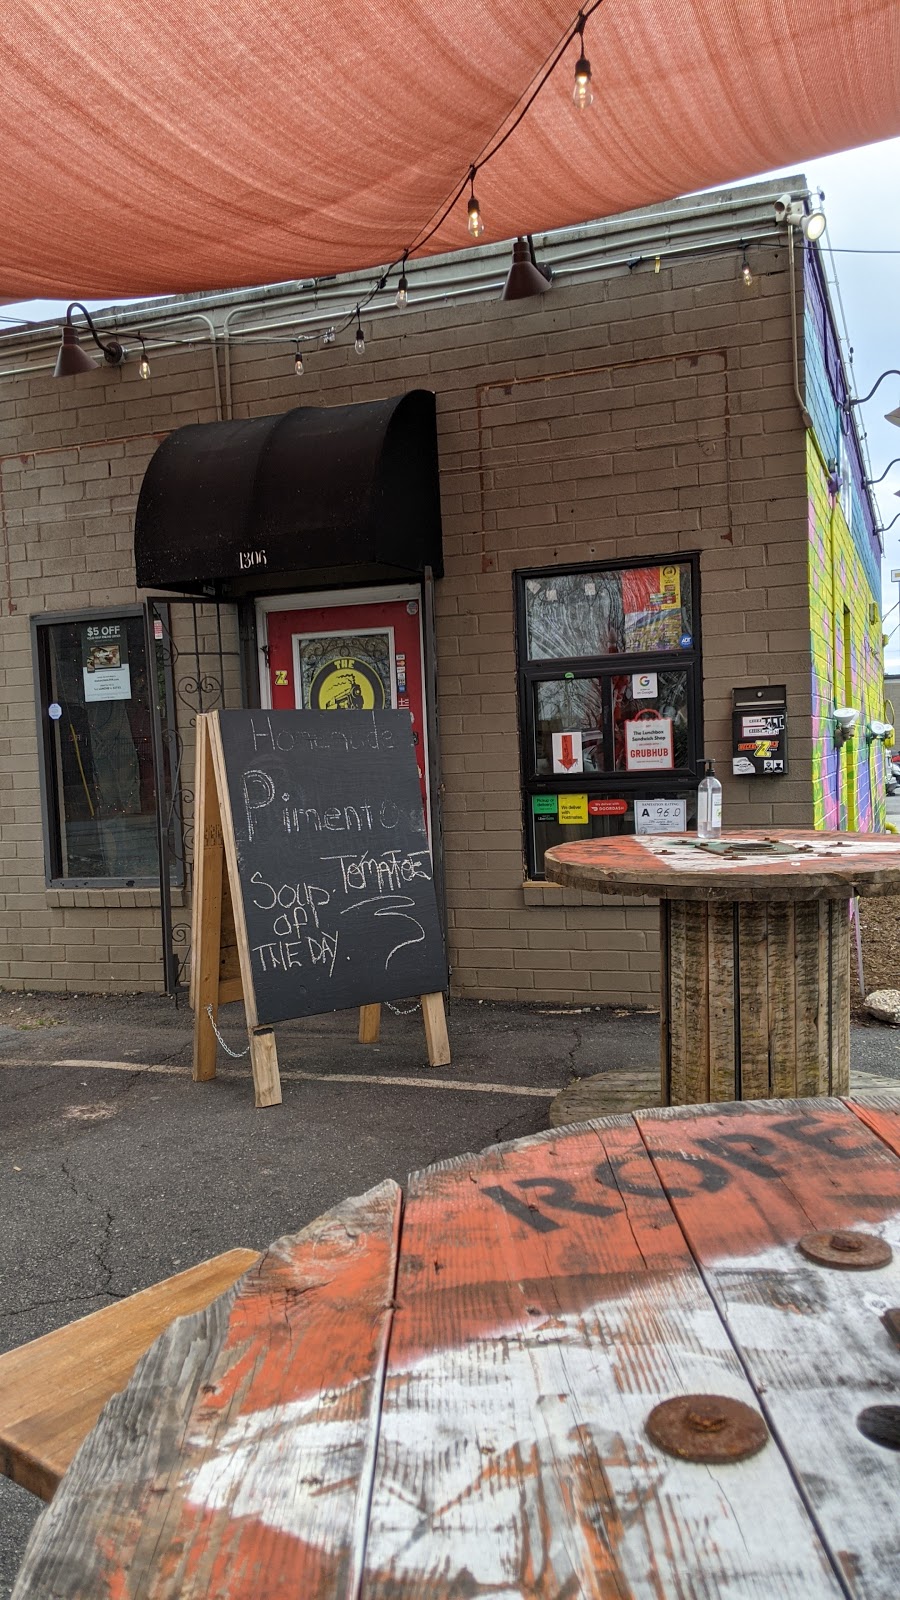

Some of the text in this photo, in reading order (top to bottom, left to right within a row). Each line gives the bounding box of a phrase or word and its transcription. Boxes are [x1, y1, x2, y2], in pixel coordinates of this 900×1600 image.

[239, 549, 267, 569] 1306
[86, 625, 120, 637] $5 OFF
[334, 659, 355, 669] THE
[274, 670, 289, 686] Z
[630, 748, 669, 758] GRUBHUB
[641, 808, 650, 817] A
[252, 942, 303, 972] THE
[480, 1114, 878, 1234] ROPE
